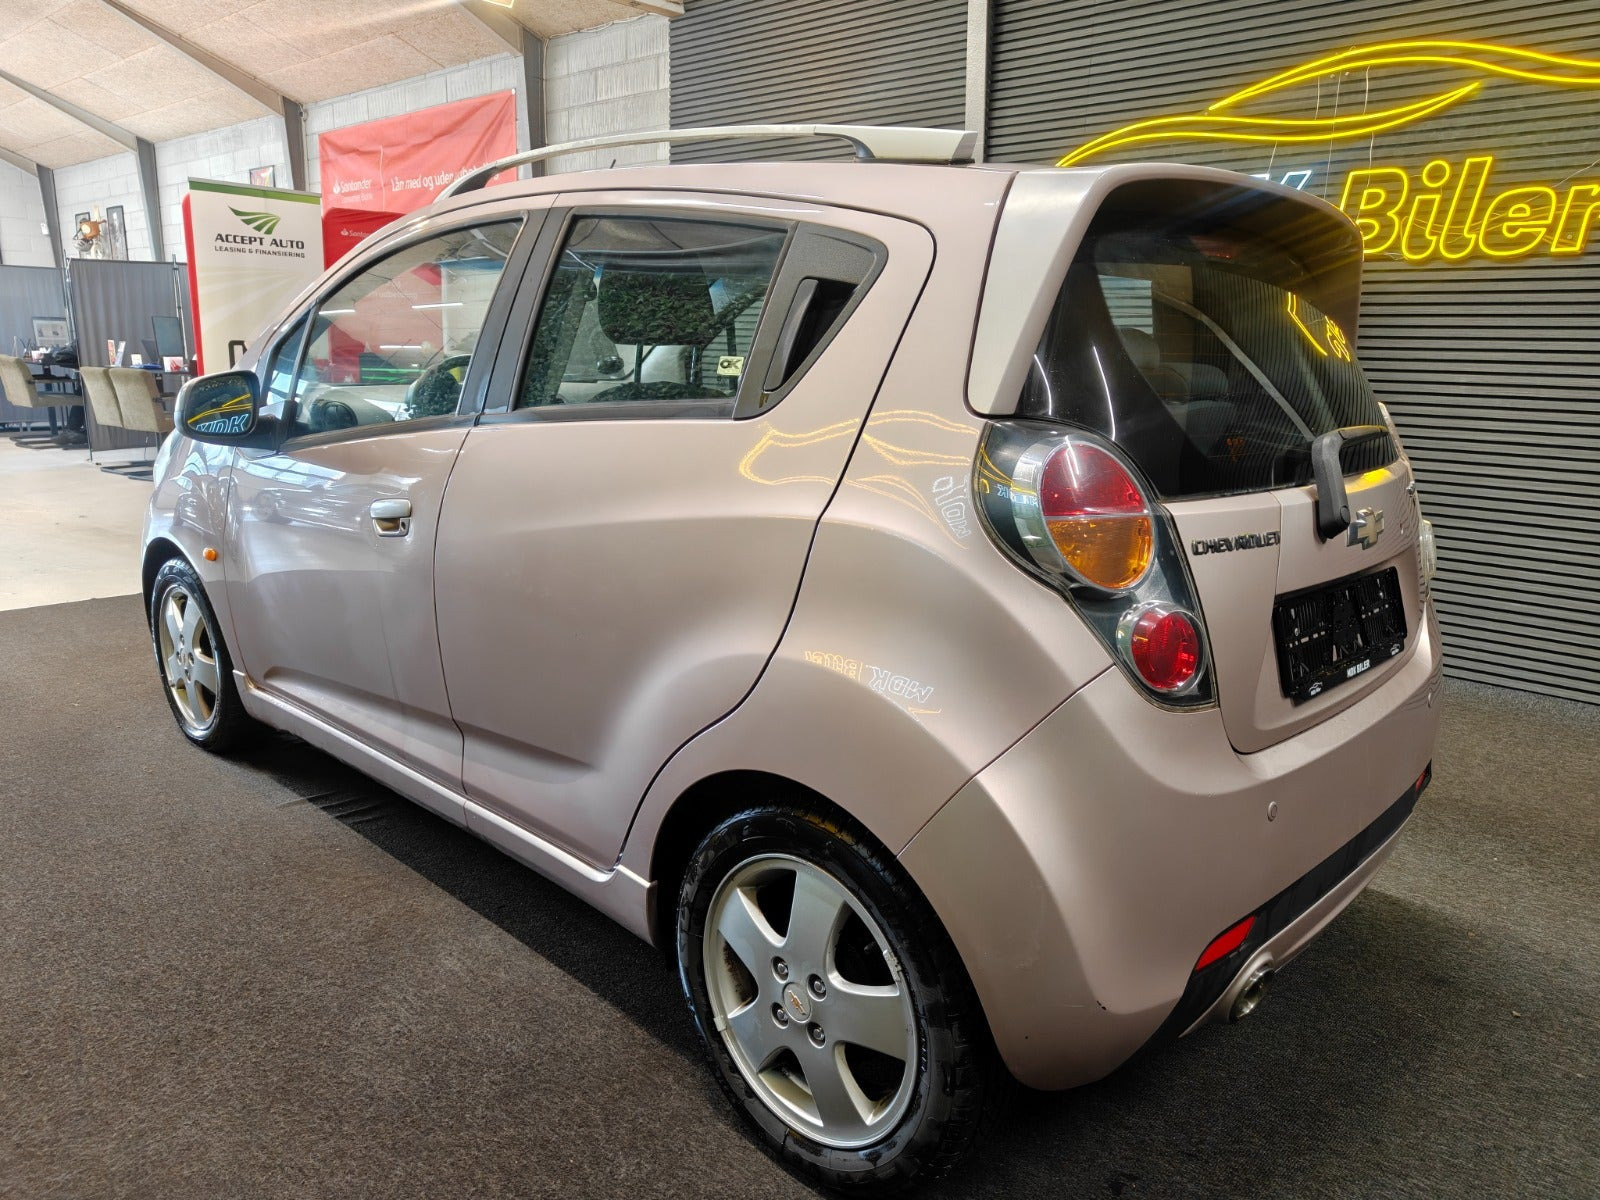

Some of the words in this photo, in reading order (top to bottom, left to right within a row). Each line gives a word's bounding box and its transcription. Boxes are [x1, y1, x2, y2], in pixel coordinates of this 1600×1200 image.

[340, 180, 371, 193] Santander
[391, 176, 404, 191] Lån
[404, 174, 421, 189] med
[423, 174, 434, 190] og
[1340, 157, 1600, 259] Biler
[215, 233, 264, 246] ACCEPT
[270, 238, 305, 250] AUTO
[255, 248, 305, 258] FINANSIERING
[1192, 531, 1280, 555] CHEVROLET
